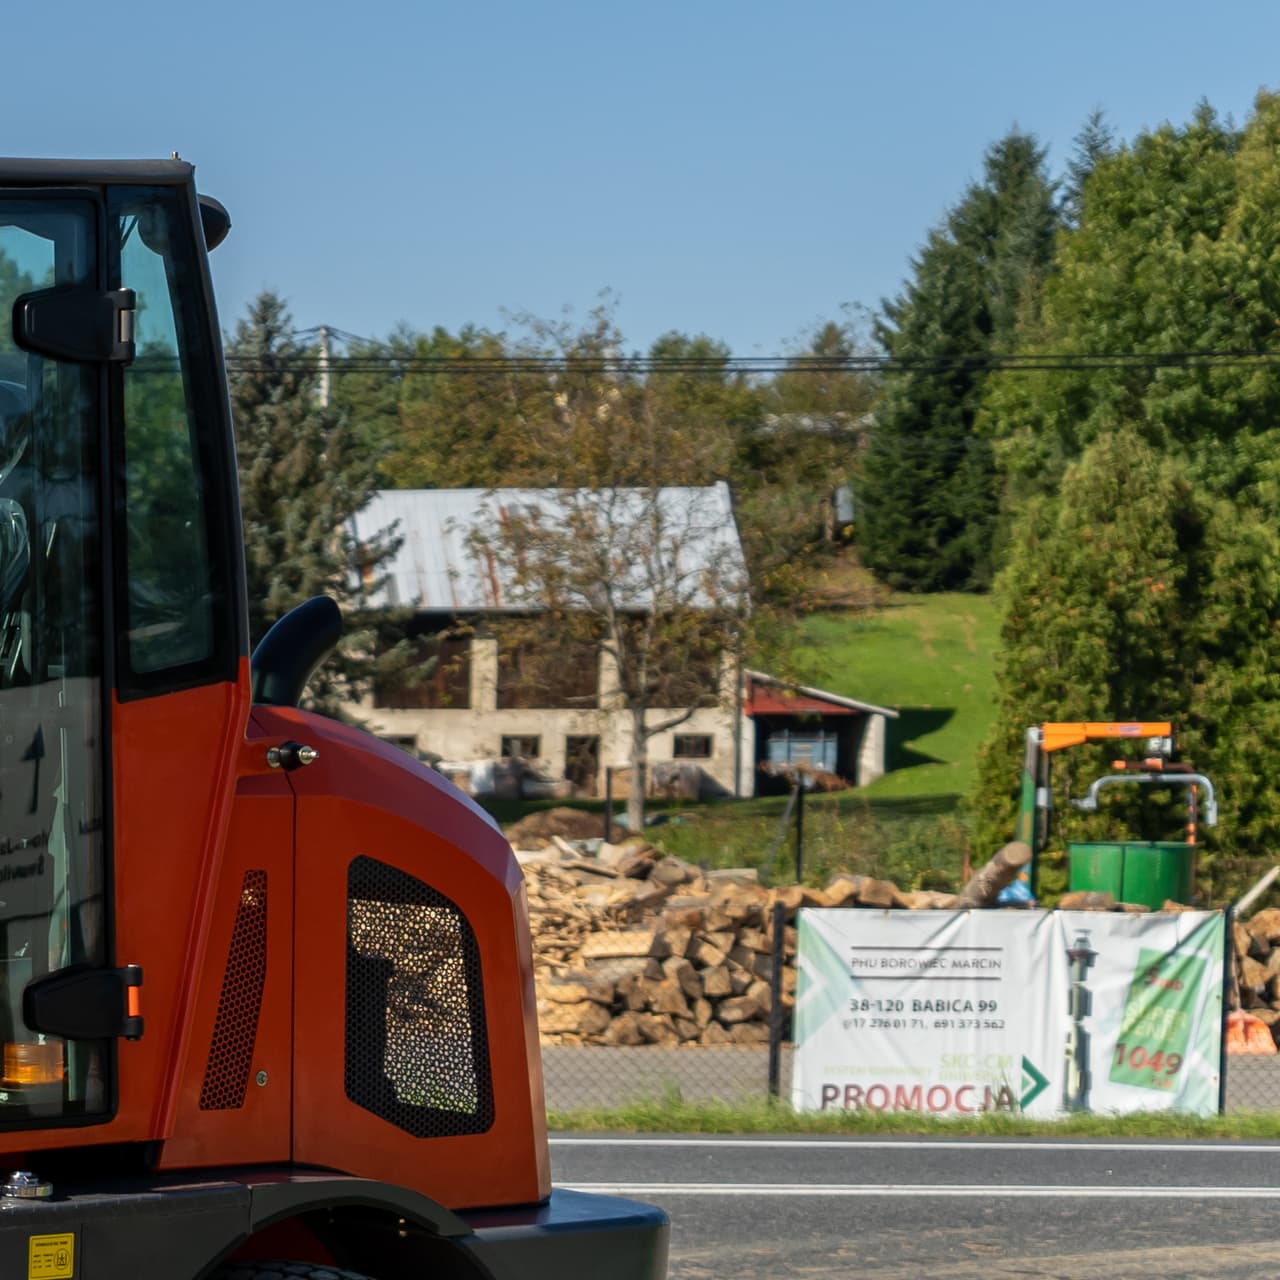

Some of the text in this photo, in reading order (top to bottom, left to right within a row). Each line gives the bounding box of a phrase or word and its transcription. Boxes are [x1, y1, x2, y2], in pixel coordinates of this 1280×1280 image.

[851, 958, 1002, 969] PHU BOROWIEC MARCIN
[849, 998, 998, 1013] 38-120 BABICA 99
[1114, 1043, 1183, 1076] 1049
[821, 1083, 1016, 1113] PROMOCJA
